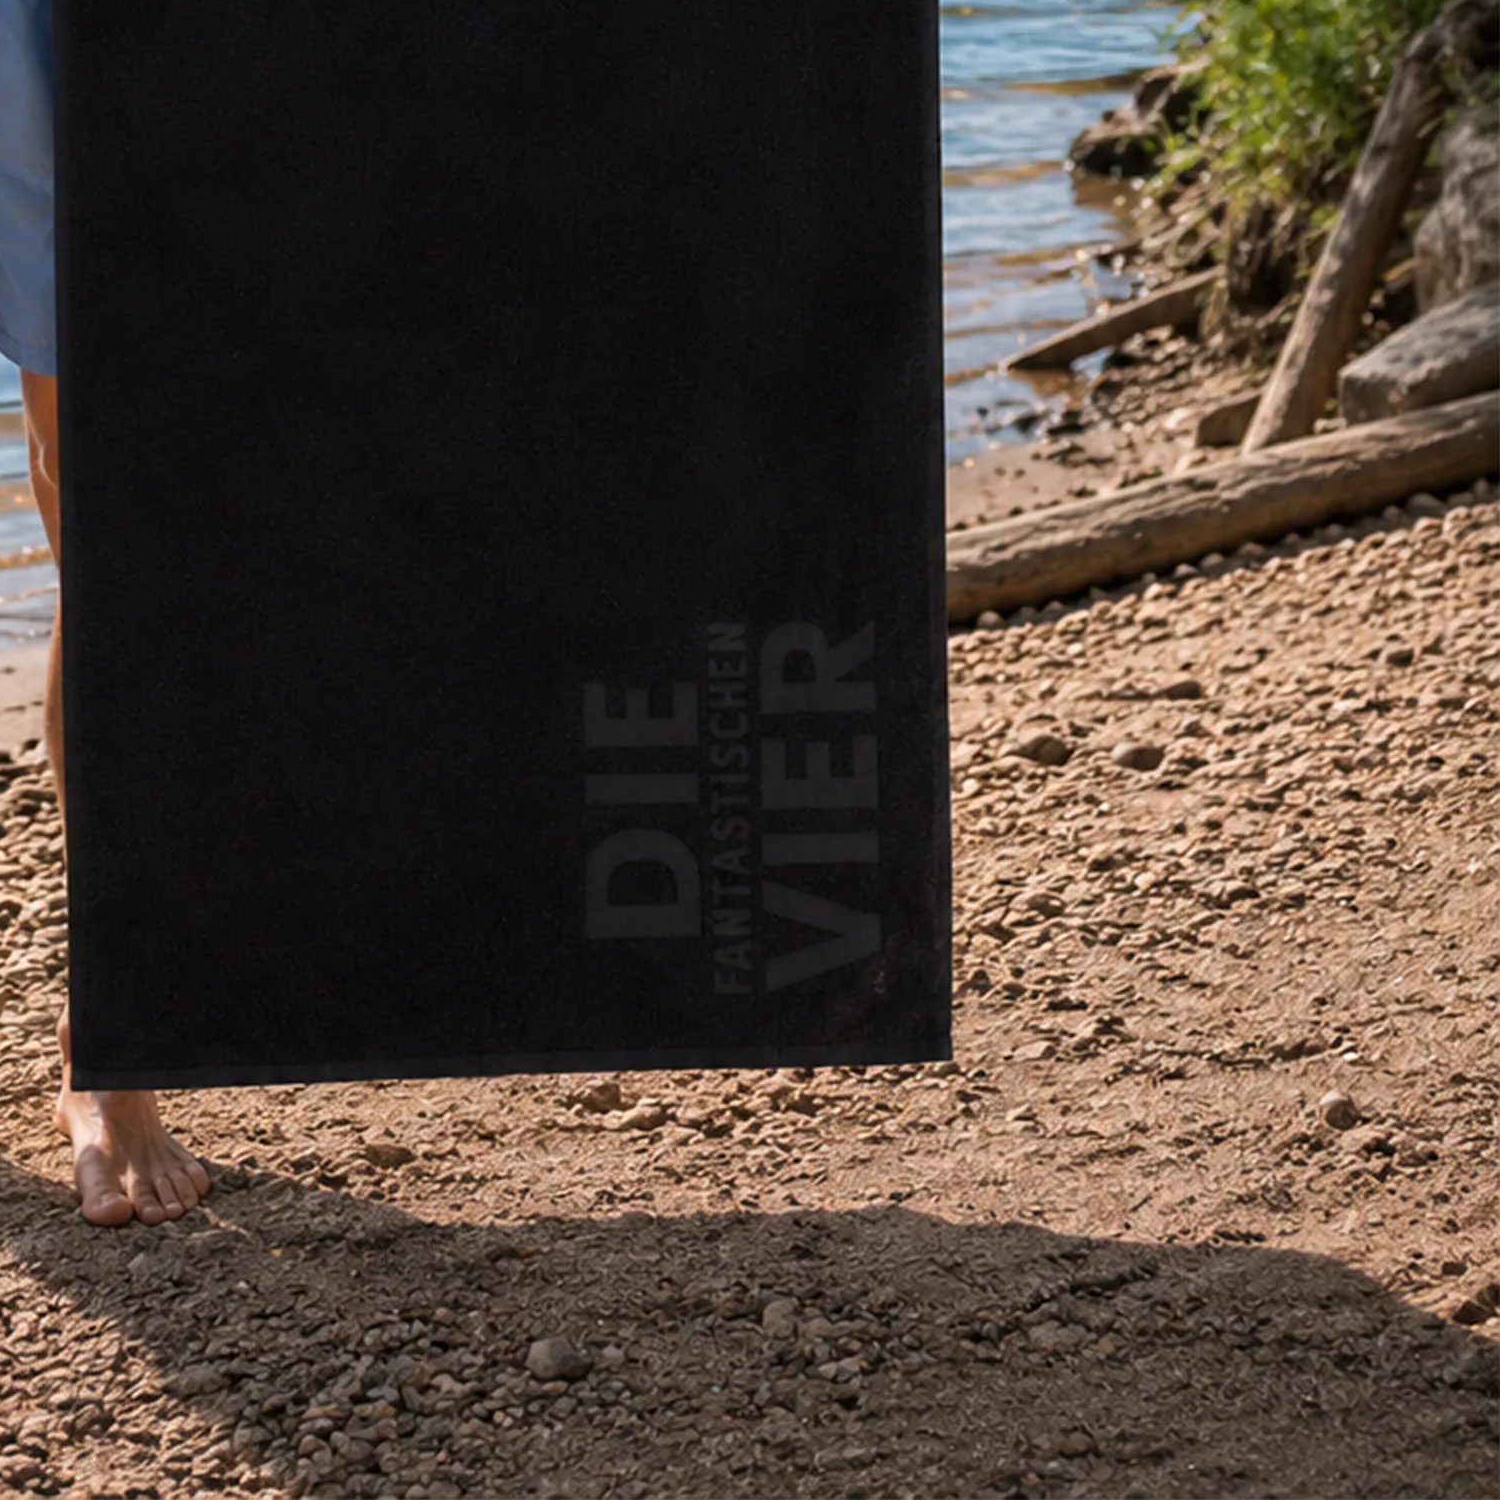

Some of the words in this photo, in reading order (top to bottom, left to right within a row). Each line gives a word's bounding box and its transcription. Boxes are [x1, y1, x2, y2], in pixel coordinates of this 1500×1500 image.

[584, 682, 701, 940] DIE
[708, 622, 752, 994] FANTASTISCHEN
[760, 620, 880, 992] VIER
